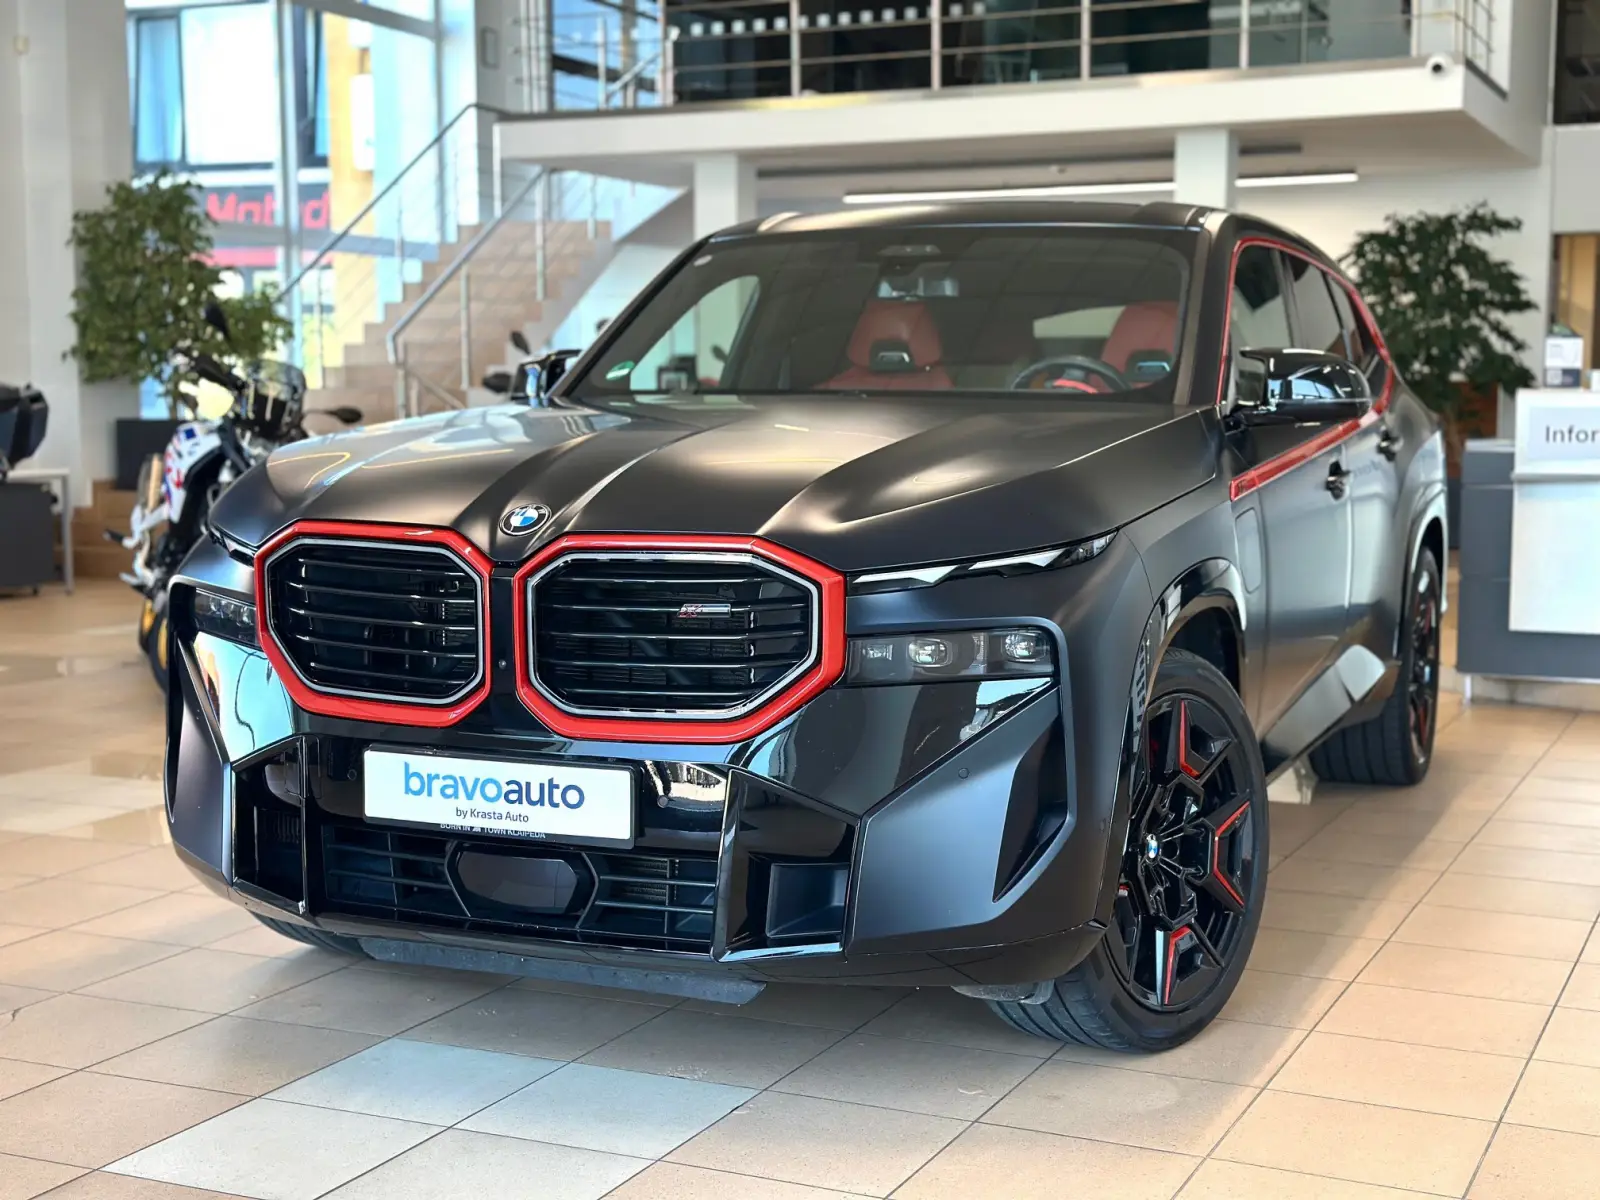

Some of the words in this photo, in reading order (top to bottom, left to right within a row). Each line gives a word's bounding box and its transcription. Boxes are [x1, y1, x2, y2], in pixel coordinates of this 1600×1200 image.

[404, 761, 585, 810] bravoauto
[455, 806, 468, 819] by
[470, 808, 503, 821] Krasta
[505, 810, 530, 823] Auto
